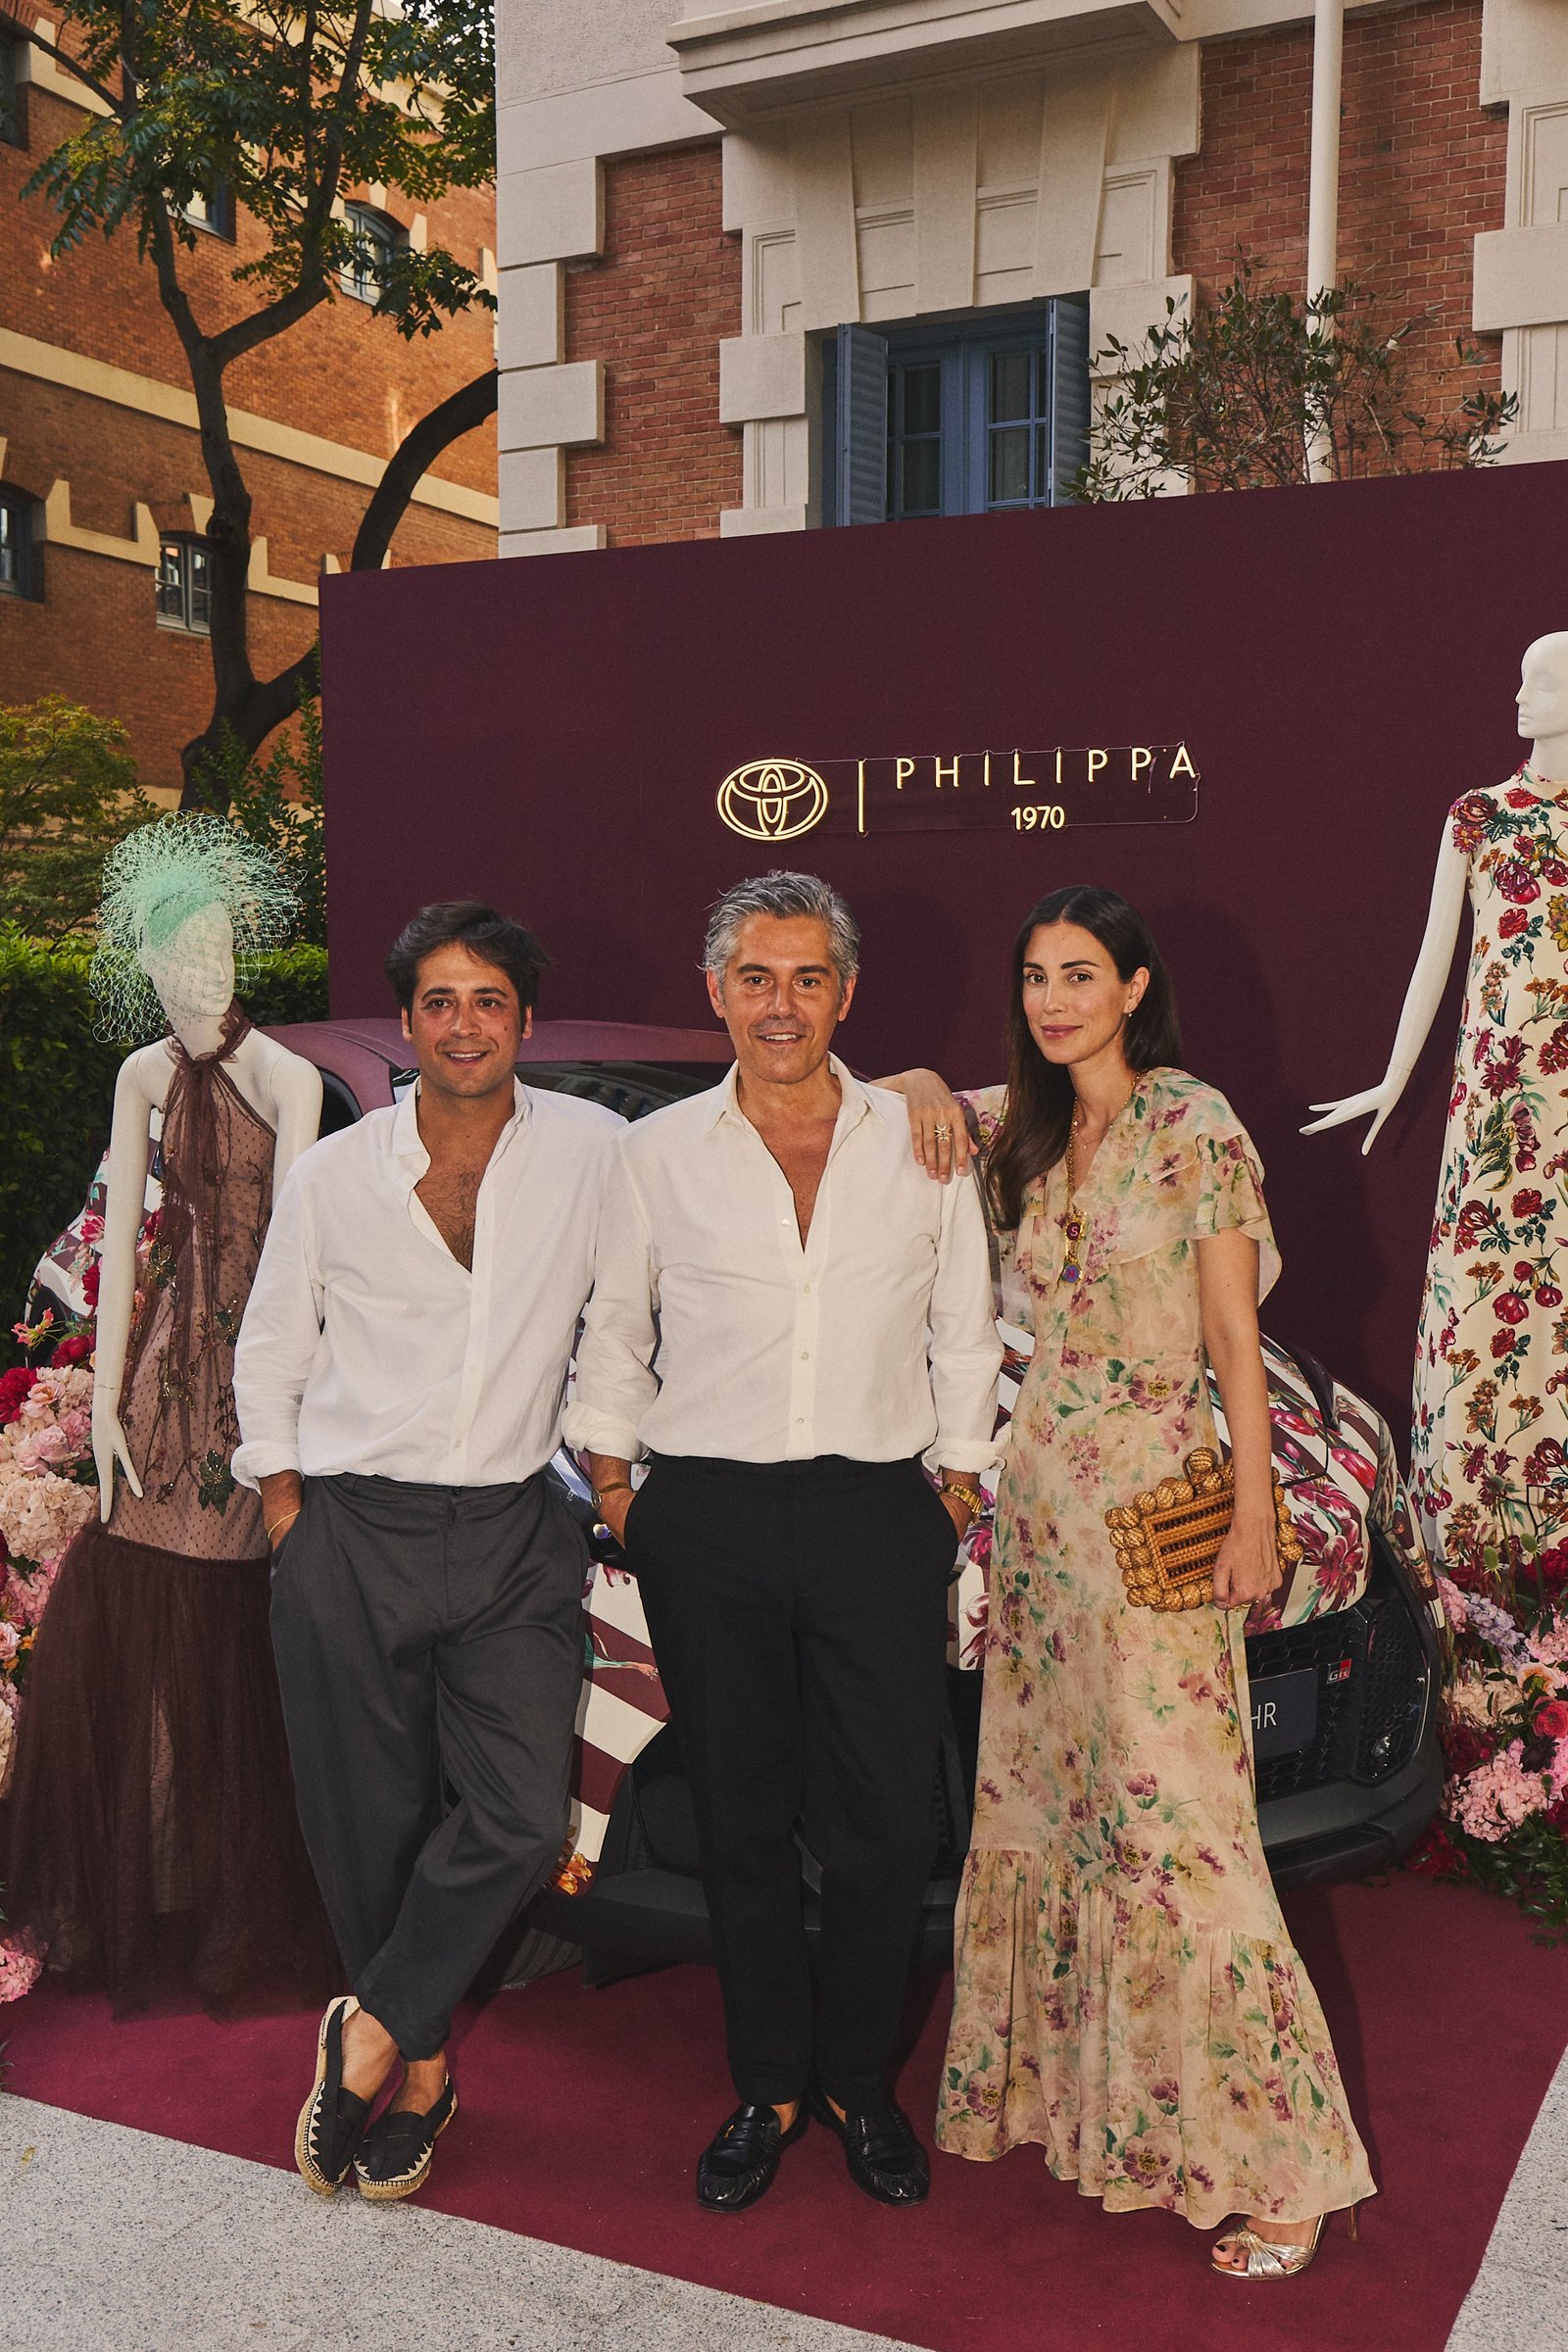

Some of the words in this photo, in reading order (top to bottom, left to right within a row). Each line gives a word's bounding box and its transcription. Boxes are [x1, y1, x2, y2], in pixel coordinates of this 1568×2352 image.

[893, 743, 1198, 790] PHILIPPA
[1010, 806, 1066, 831] 1970
[1070, 1226, 1079, 1237] S
